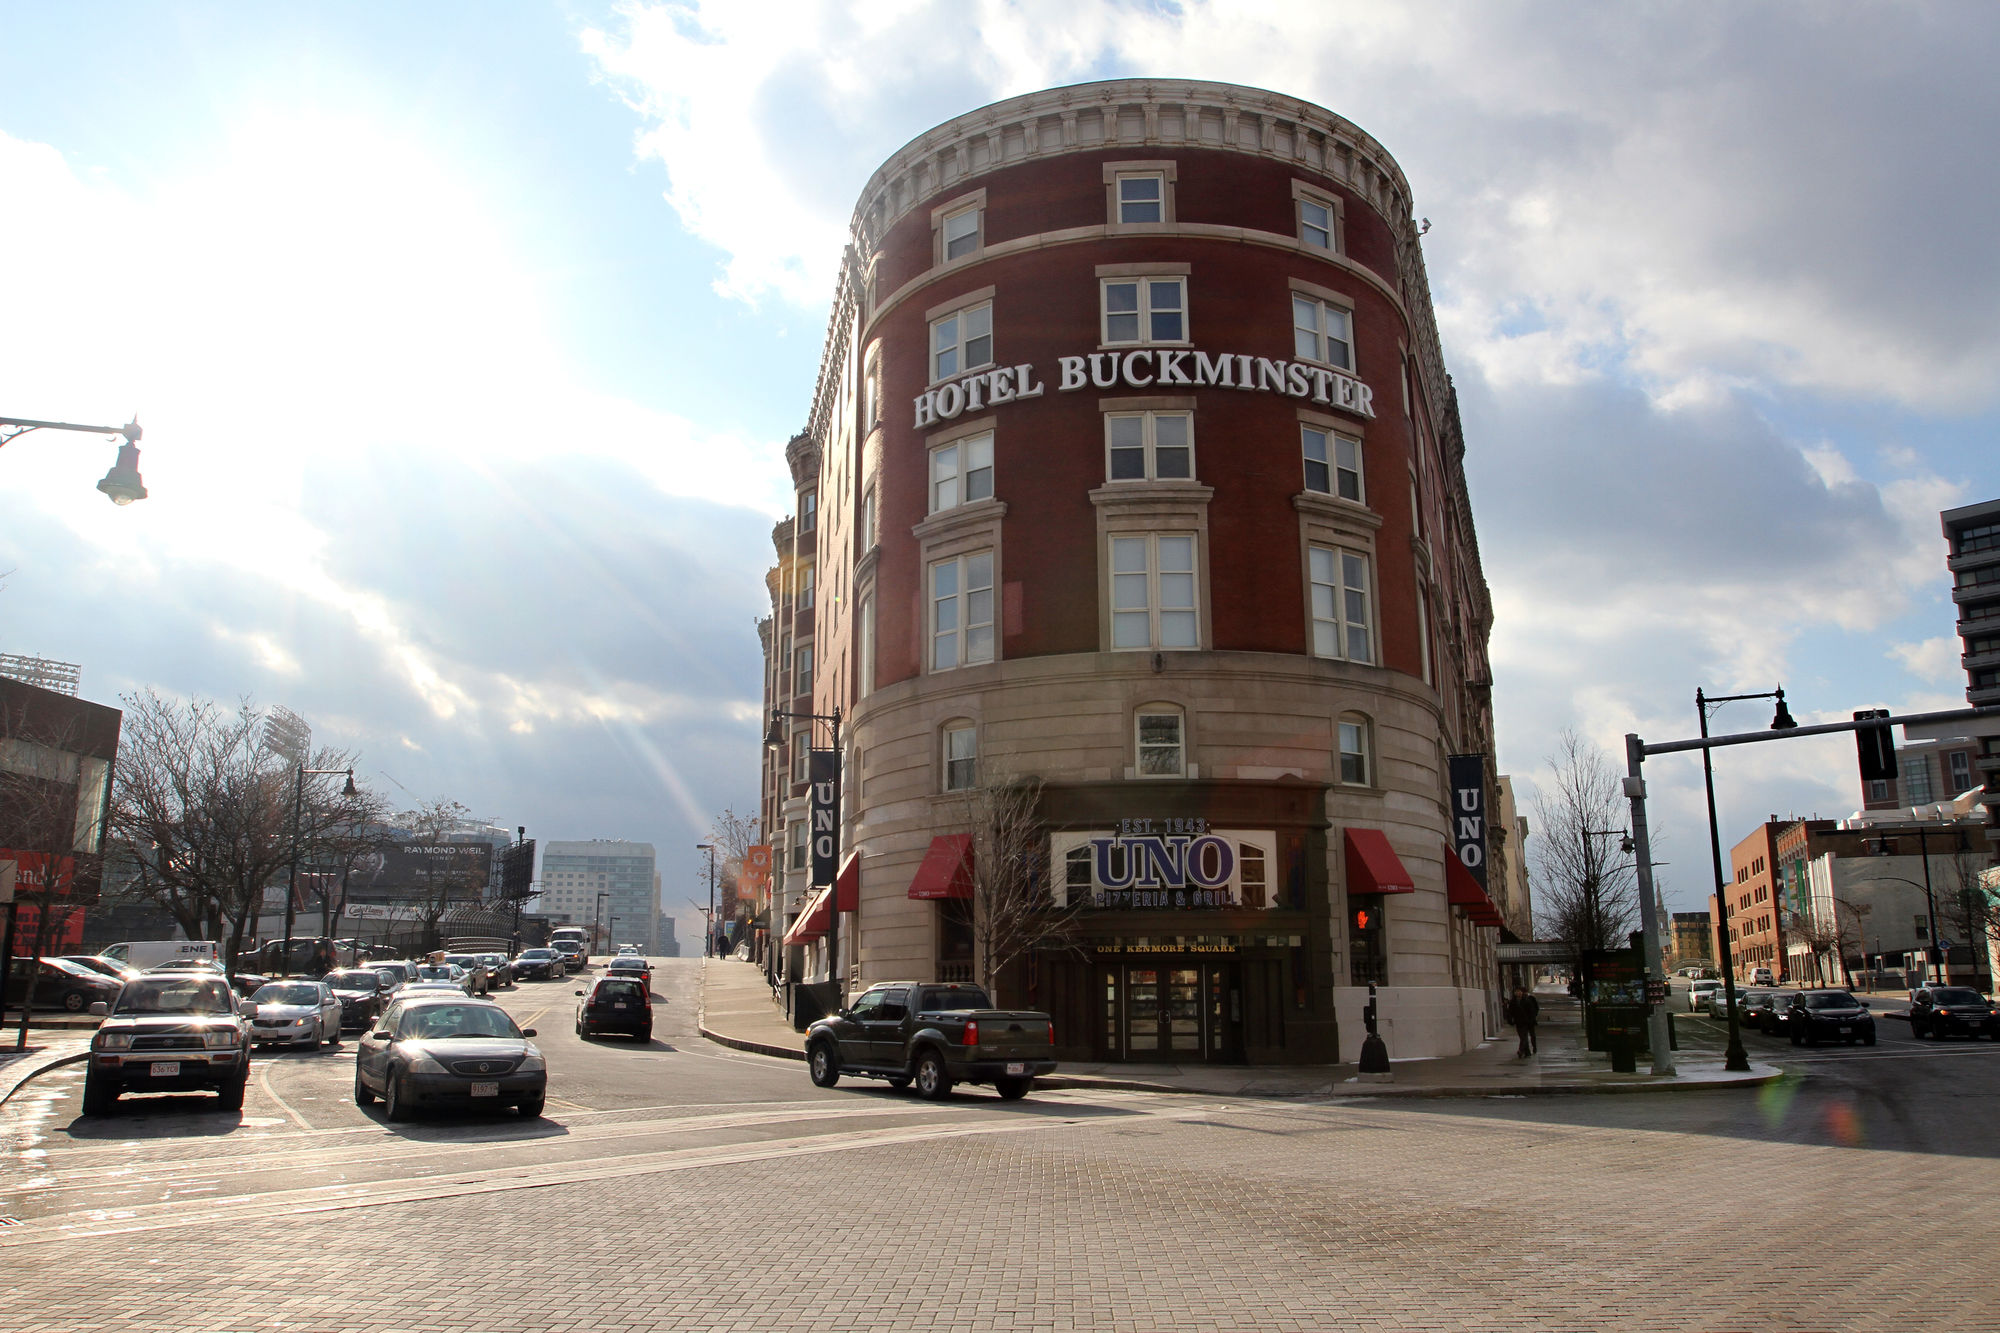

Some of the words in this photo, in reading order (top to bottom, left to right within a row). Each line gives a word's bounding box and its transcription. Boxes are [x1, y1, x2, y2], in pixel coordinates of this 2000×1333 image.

[913, 363, 1044, 429] HOTEL
[1058, 350, 1377, 420] BUCKMINSTER
[815, 782, 835, 859] UNO
[1121, 818, 1157, 833] EST.
[1164, 817, 1206, 832] 1943
[1458, 788, 1483, 868] UNO
[403, 846, 456, 855] RAYMOND
[460, 847, 485, 855] WEIL
[1088, 834, 1235, 890] UNO
[1175, 890, 1187, 906] &
[1192, 890, 1238, 906] GRILL
[1097, 945, 1121, 953] ONE
[1126, 944, 1185, 953] KENMORE
[1190, 944, 1236, 953] SQUARE
